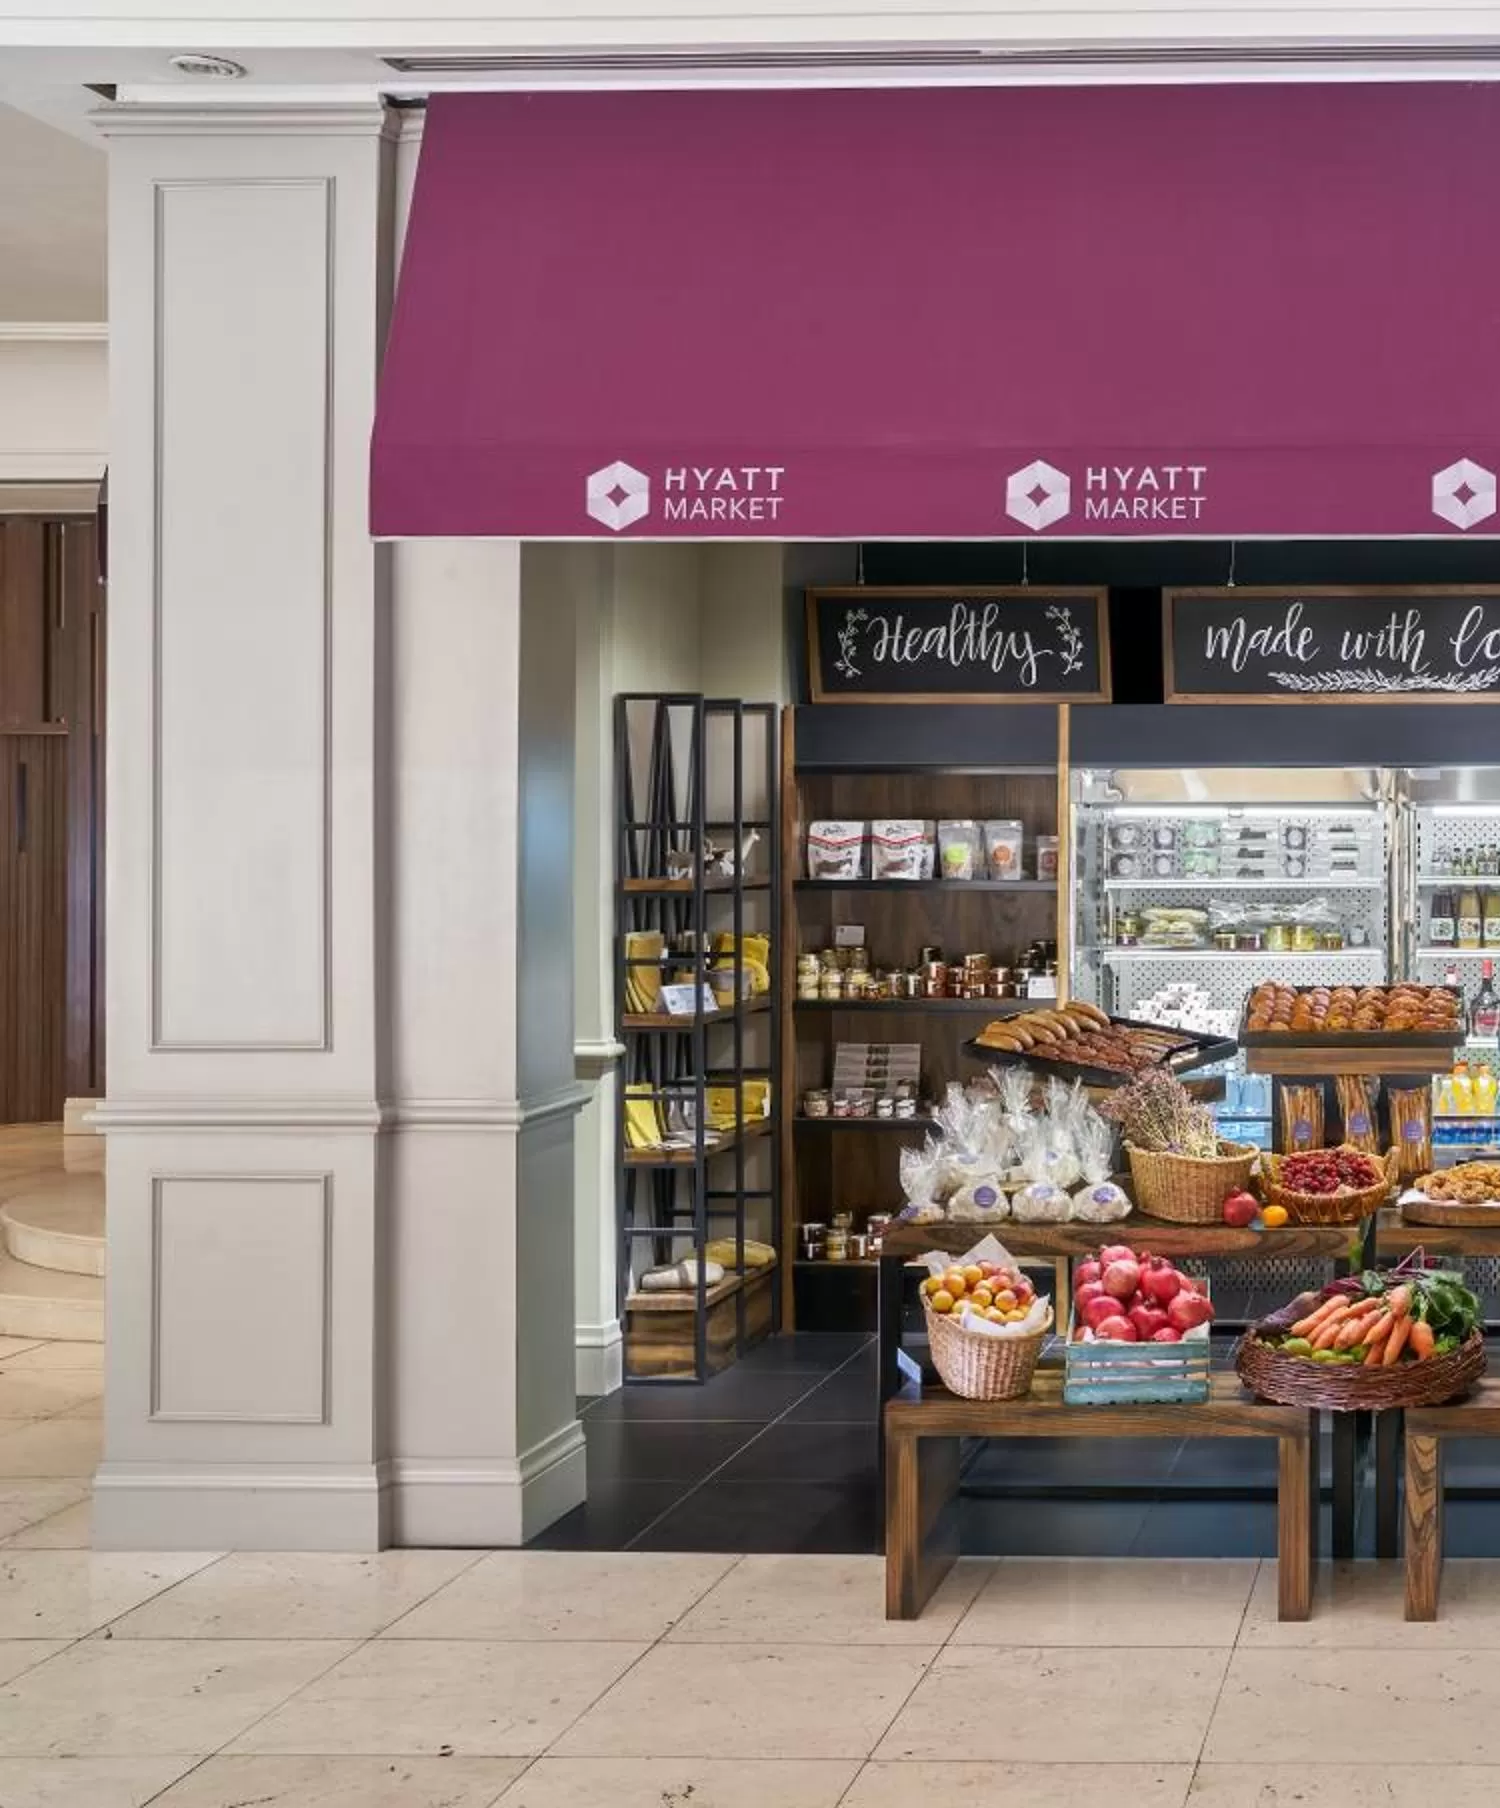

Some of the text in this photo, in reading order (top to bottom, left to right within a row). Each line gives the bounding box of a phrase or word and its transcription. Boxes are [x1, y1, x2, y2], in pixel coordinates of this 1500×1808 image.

[665, 467, 785, 491] HYATT
[1087, 466, 1207, 491] HYATT
[664, 497, 784, 520] MARKET
[1085, 496, 1206, 519] MARKET
[866, 603, 1053, 686] Healthy
[1206, 602, 1321, 673] made
[1340, 609, 1430, 673] with
